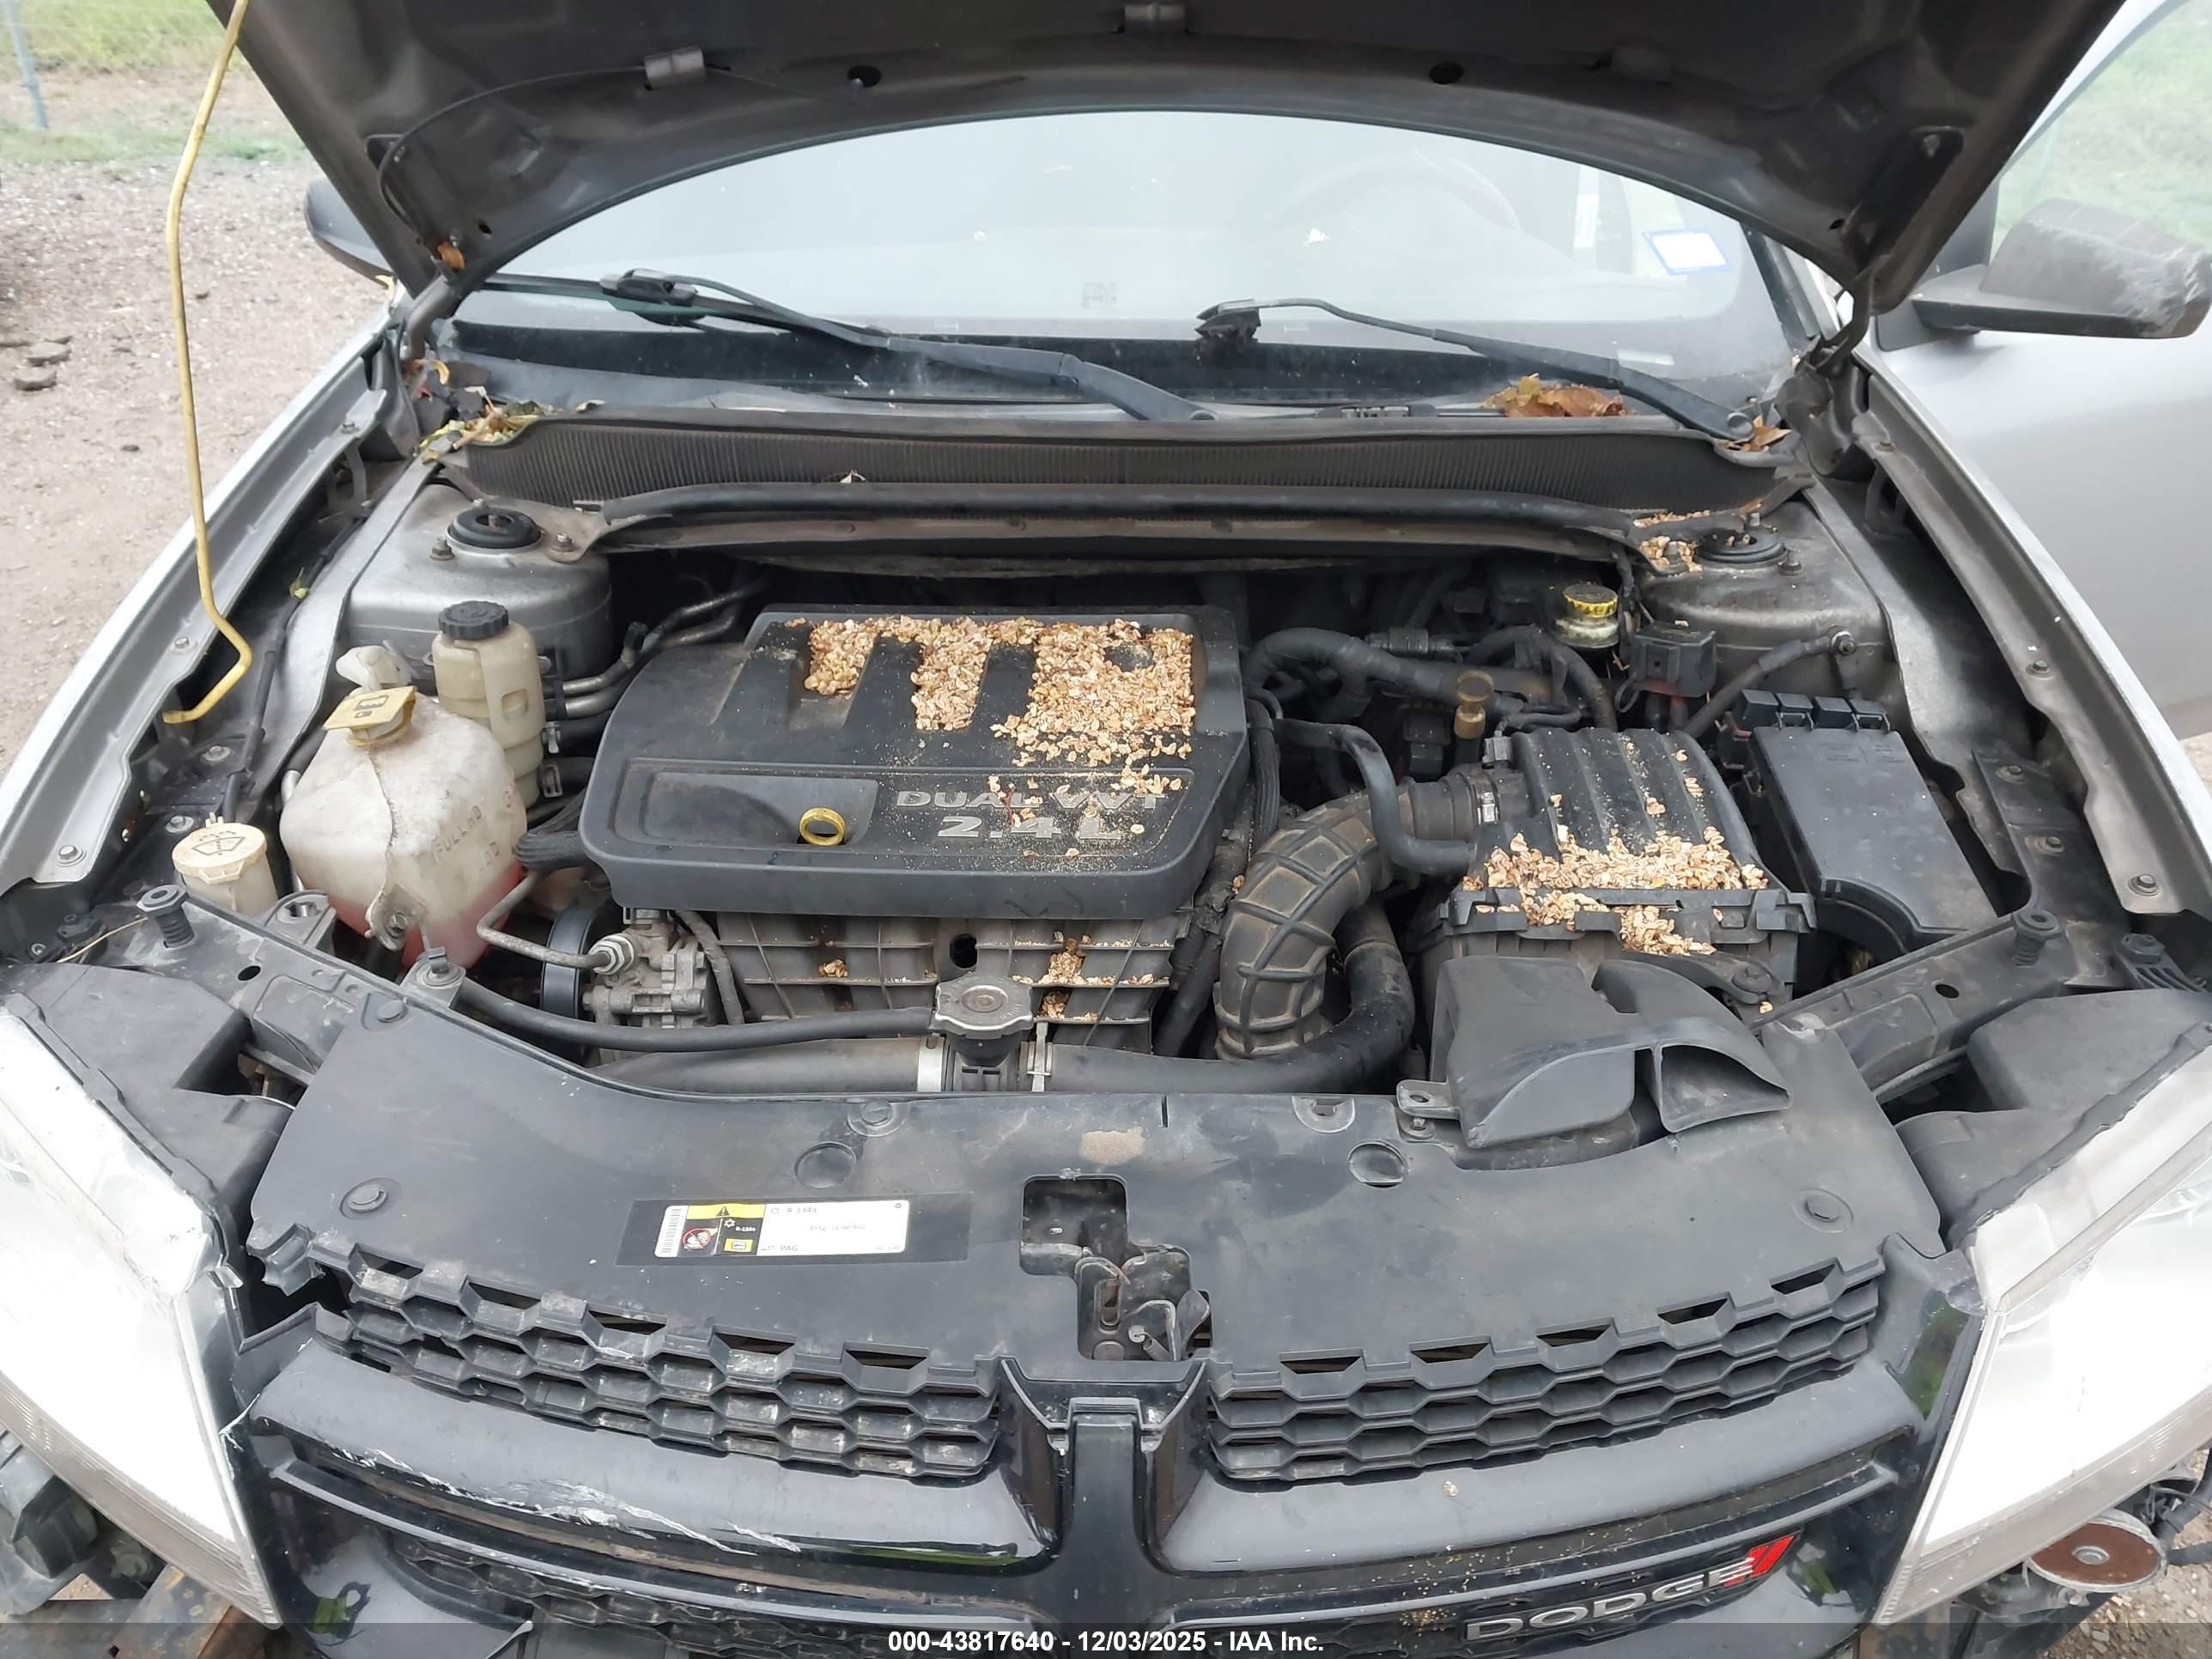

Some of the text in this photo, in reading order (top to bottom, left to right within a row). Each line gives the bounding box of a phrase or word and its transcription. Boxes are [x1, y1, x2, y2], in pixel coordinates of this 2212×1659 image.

[896, 790, 1166, 810] DUAL VVT
[1464, 1556, 1756, 1642] DODGE
